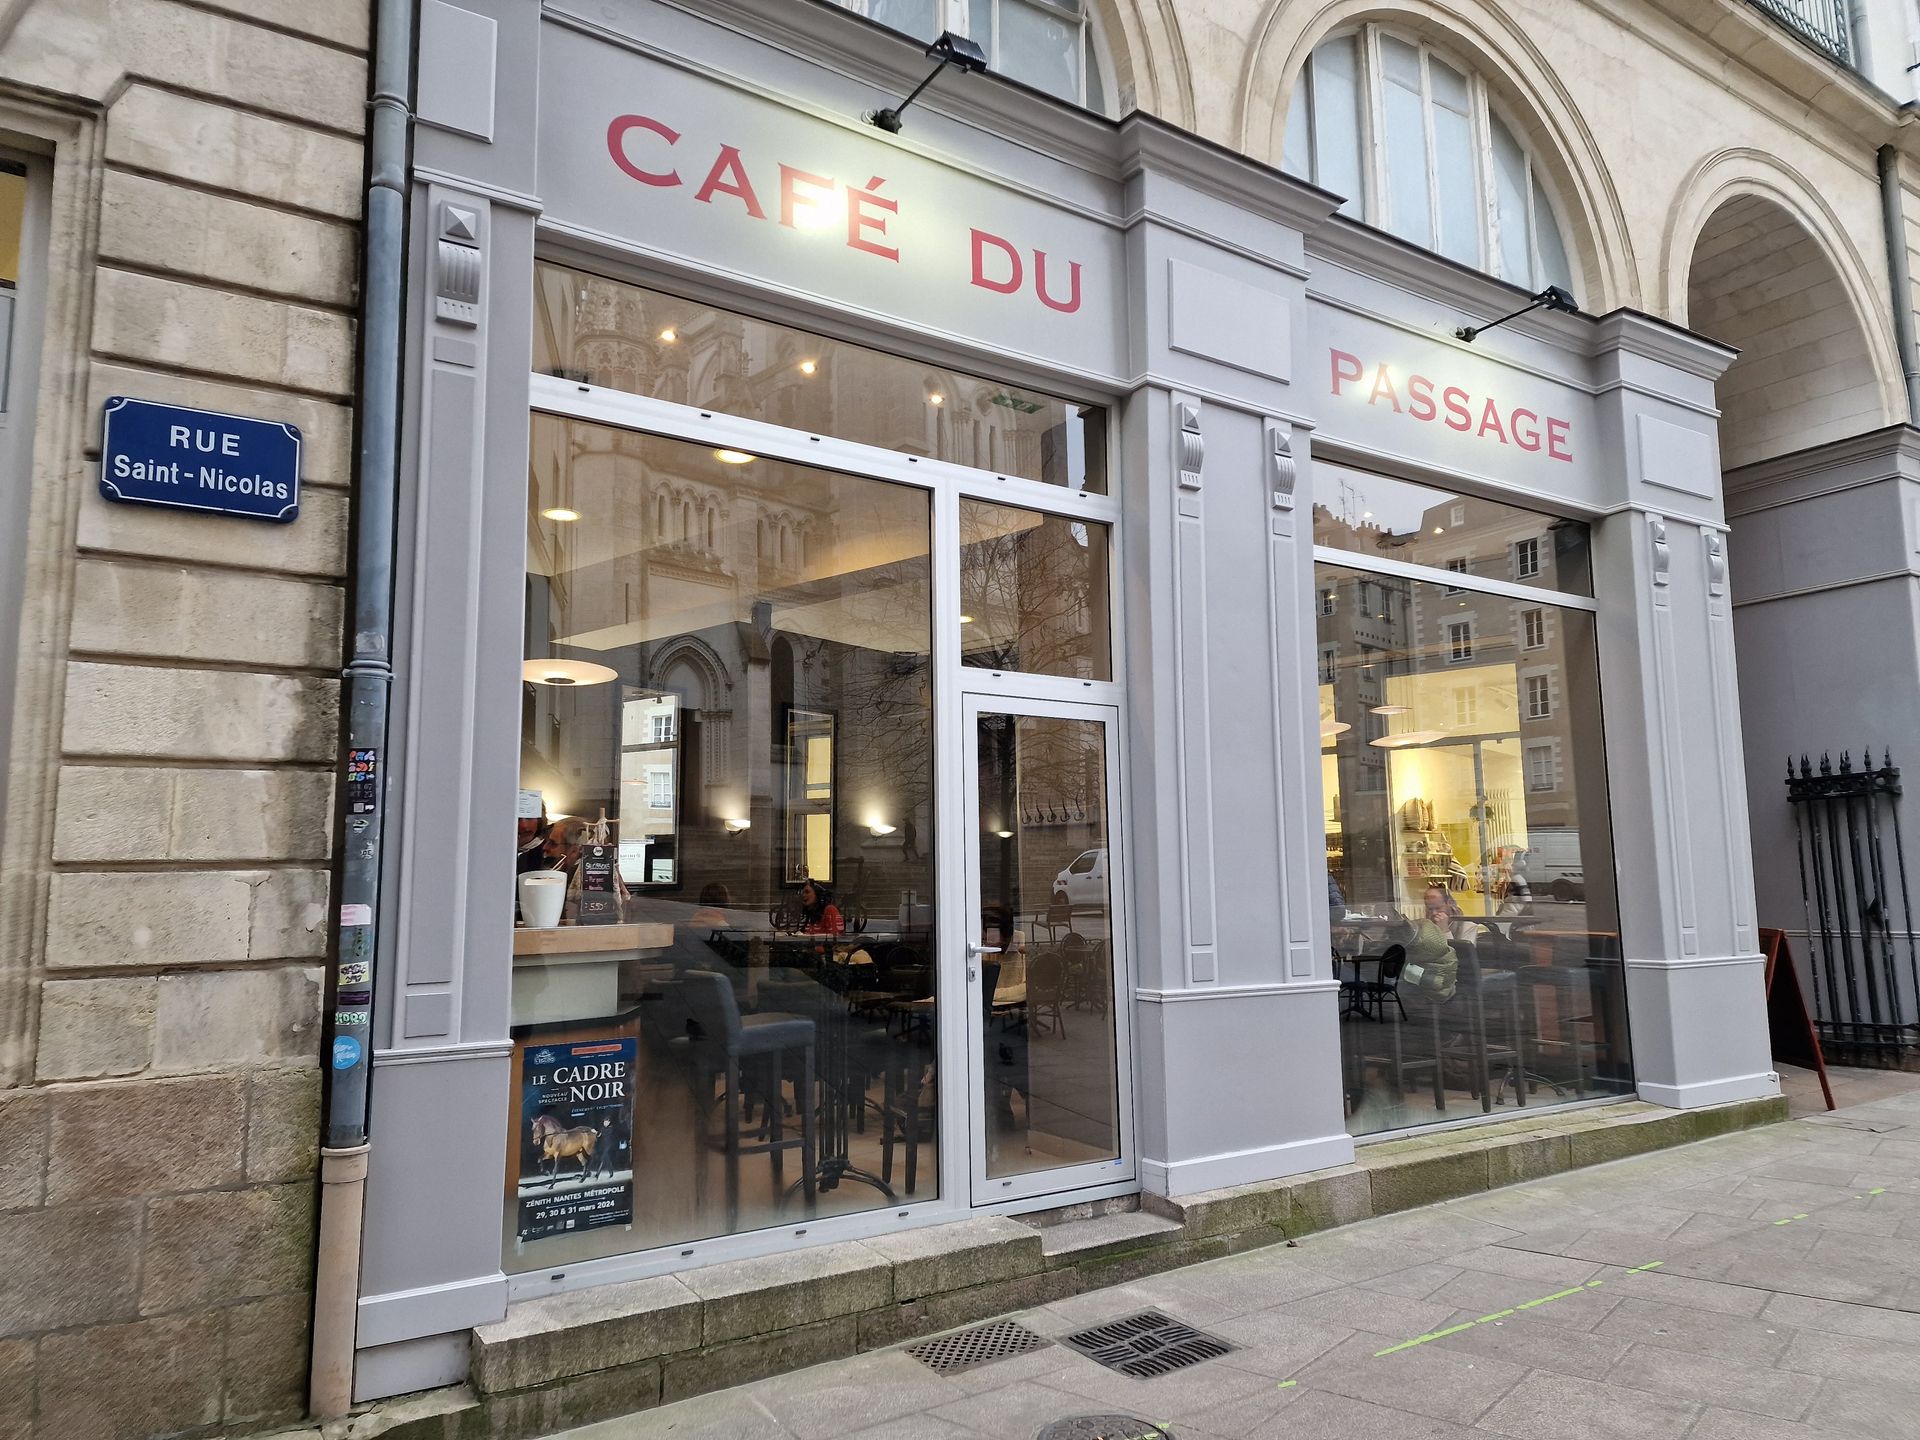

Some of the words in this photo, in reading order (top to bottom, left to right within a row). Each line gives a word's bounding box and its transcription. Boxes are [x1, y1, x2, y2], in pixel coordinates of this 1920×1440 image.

[607, 114, 899, 263] CAFÉ
[969, 227, 1082, 313] DU
[1329, 347, 1573, 463] PASSAGE
[169, 425, 240, 457] RUE
[113, 454, 289, 500] Saint-Nicolas
[532, 1075, 547, 1085] LE
[553, 1061, 626, 1084] CADRE
[570, 1082, 625, 1102] NOIR
[526, 1198, 551, 1207] ZÉNITH
[554, 1193, 581, 1203] NANTES
[584, 1186, 624, 1197] MÉTROPOLE
[549, 1209, 559, 1217] 30
[560, 1207, 567, 1215] &
[568, 1206, 577, 1214] 31
[597, 1200, 614, 1208] 2024
